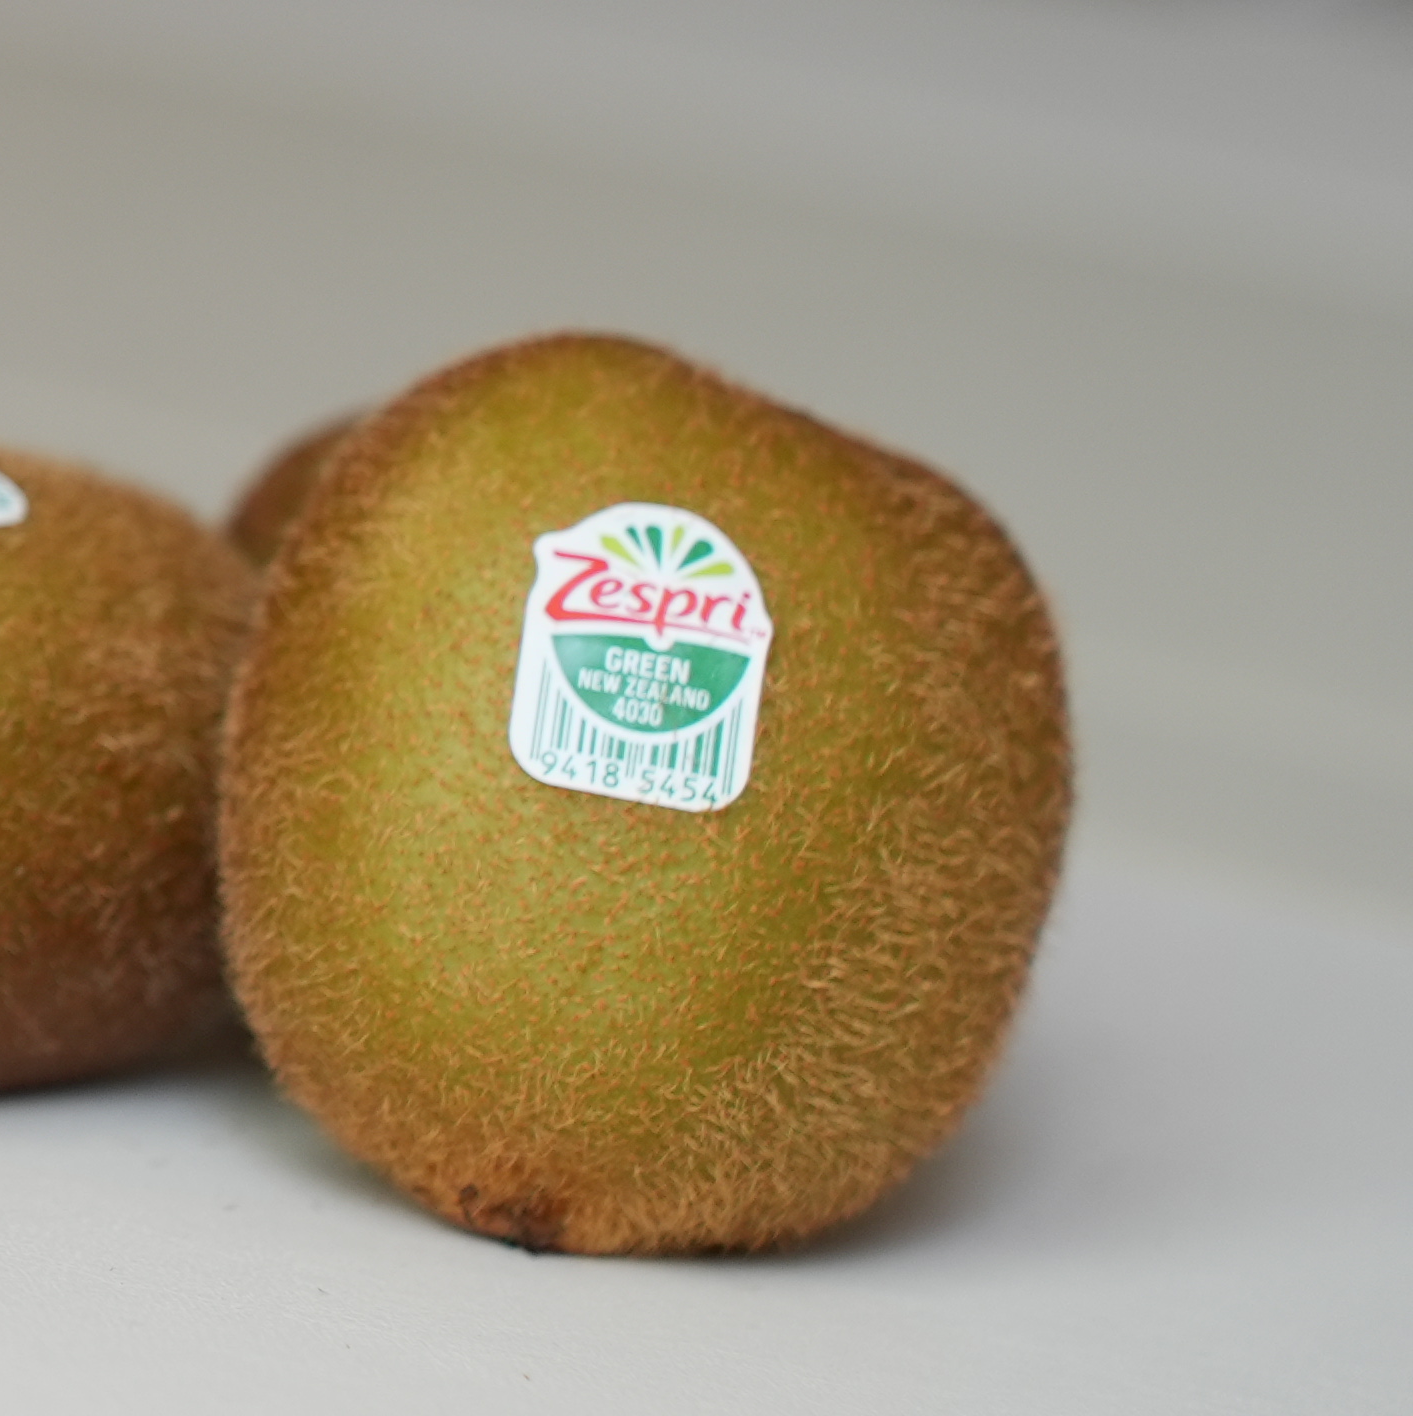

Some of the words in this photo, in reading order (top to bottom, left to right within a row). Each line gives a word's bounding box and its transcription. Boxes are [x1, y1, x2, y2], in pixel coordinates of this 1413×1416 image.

[545, 550, 751, 643] Zespri
[605, 646, 692, 685] GREEN
[578, 667, 622, 694] NEW
[624, 678, 711, 711] ZEALAND
[612, 697, 664, 727] 4030
[540, 750, 620, 788] 9418
[638, 767, 717, 803] 5454
